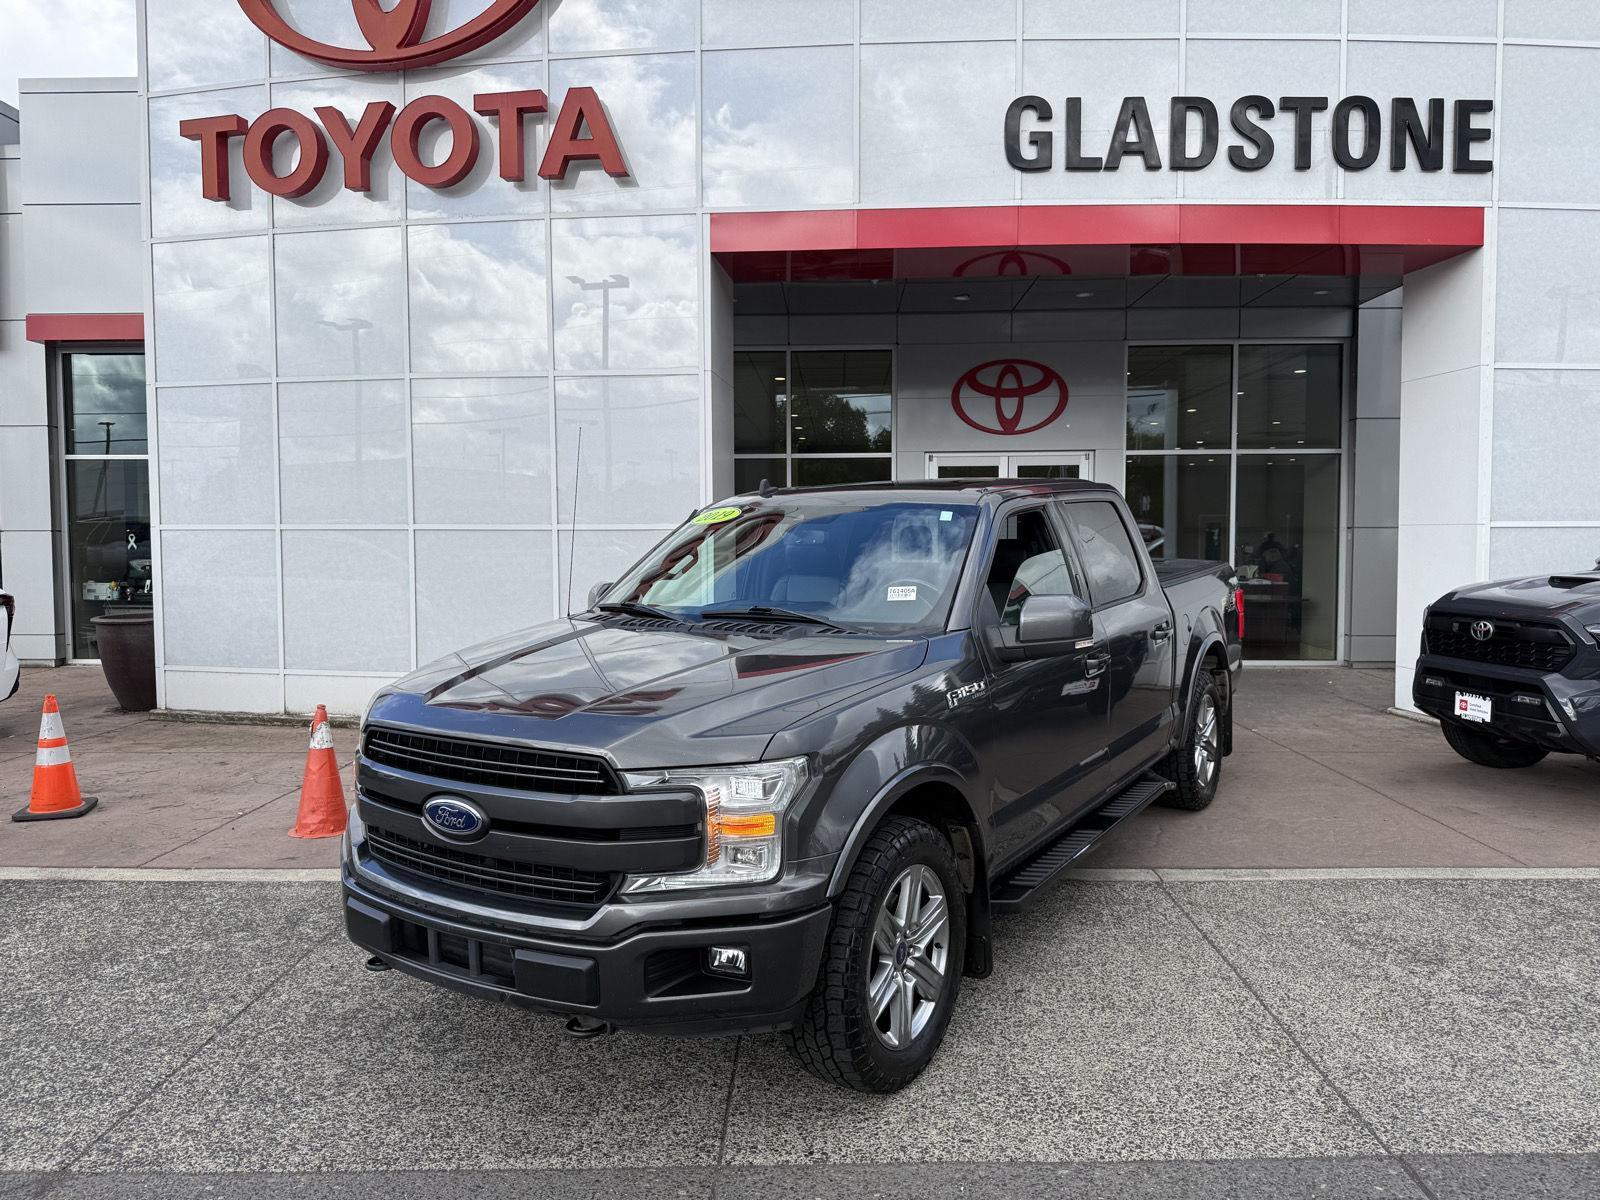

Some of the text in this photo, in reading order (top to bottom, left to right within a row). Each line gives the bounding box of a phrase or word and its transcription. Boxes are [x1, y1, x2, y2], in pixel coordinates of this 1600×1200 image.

[180, 87, 630, 202] TOYOTA
[1004, 94, 1494, 173] GLADSTONE
[695, 509, 736, 522] 2019
[435, 806, 466, 828] Ford
